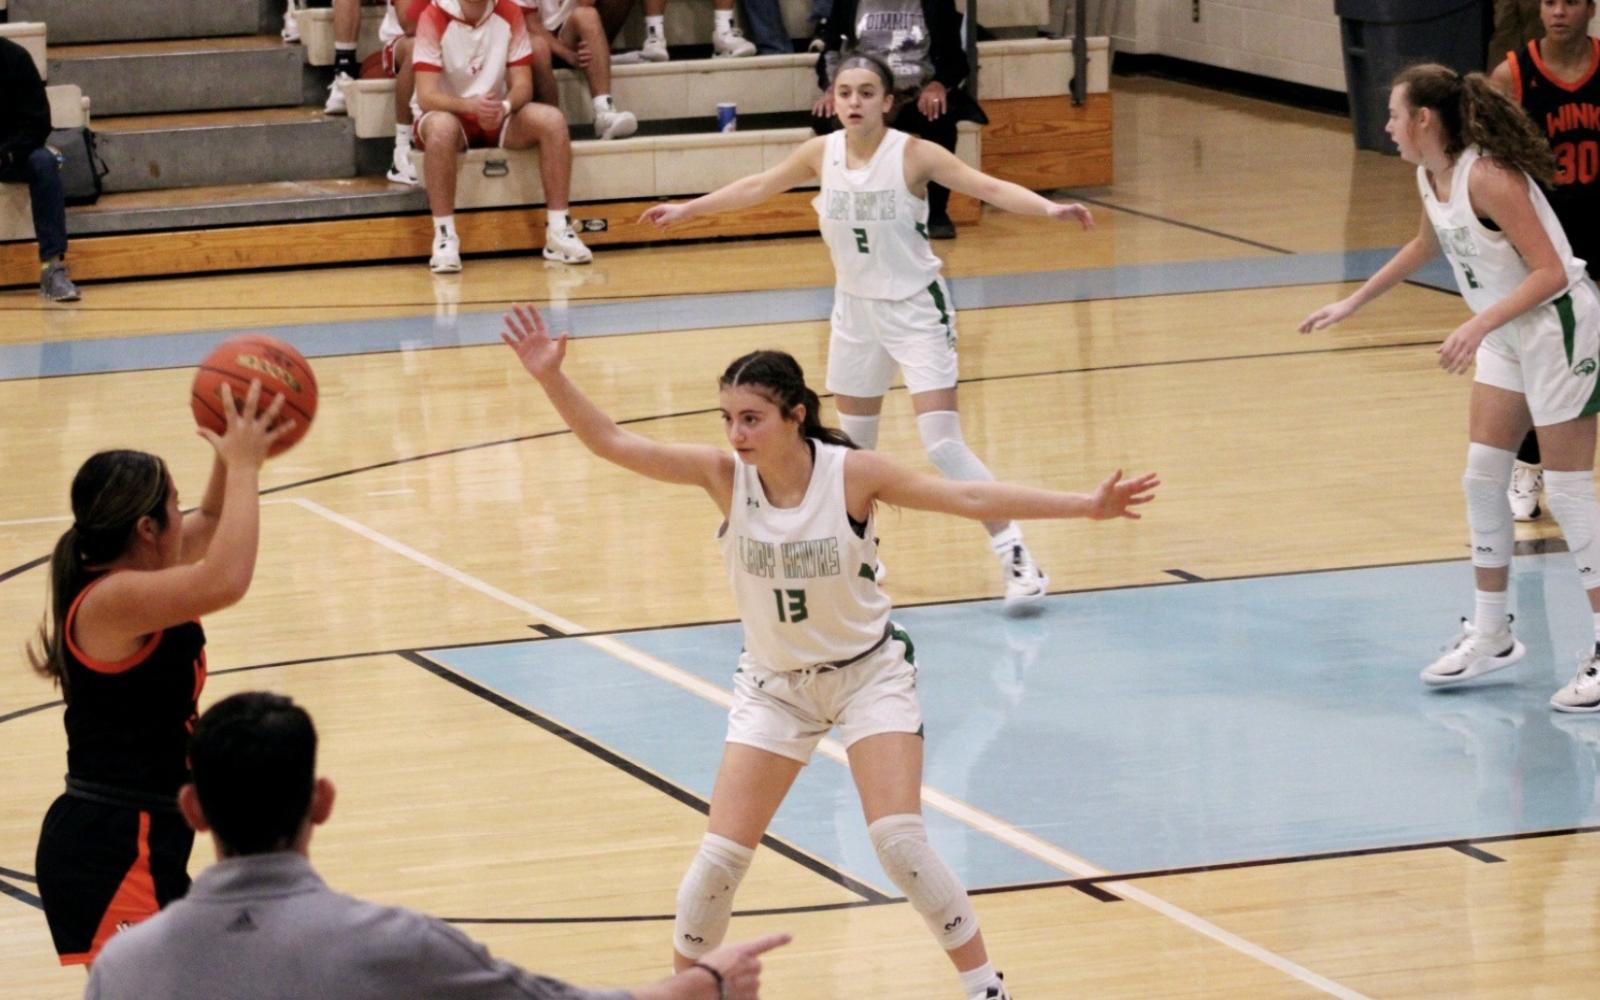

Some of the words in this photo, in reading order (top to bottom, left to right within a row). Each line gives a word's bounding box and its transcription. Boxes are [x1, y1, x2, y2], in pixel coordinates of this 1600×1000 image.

[1552, 140, 1599, 185] 30
[852, 228, 869, 254] 2
[738, 535, 776, 578] LADY
[780, 536, 841, 579] HAWKS
[773, 588, 809, 623] 13
